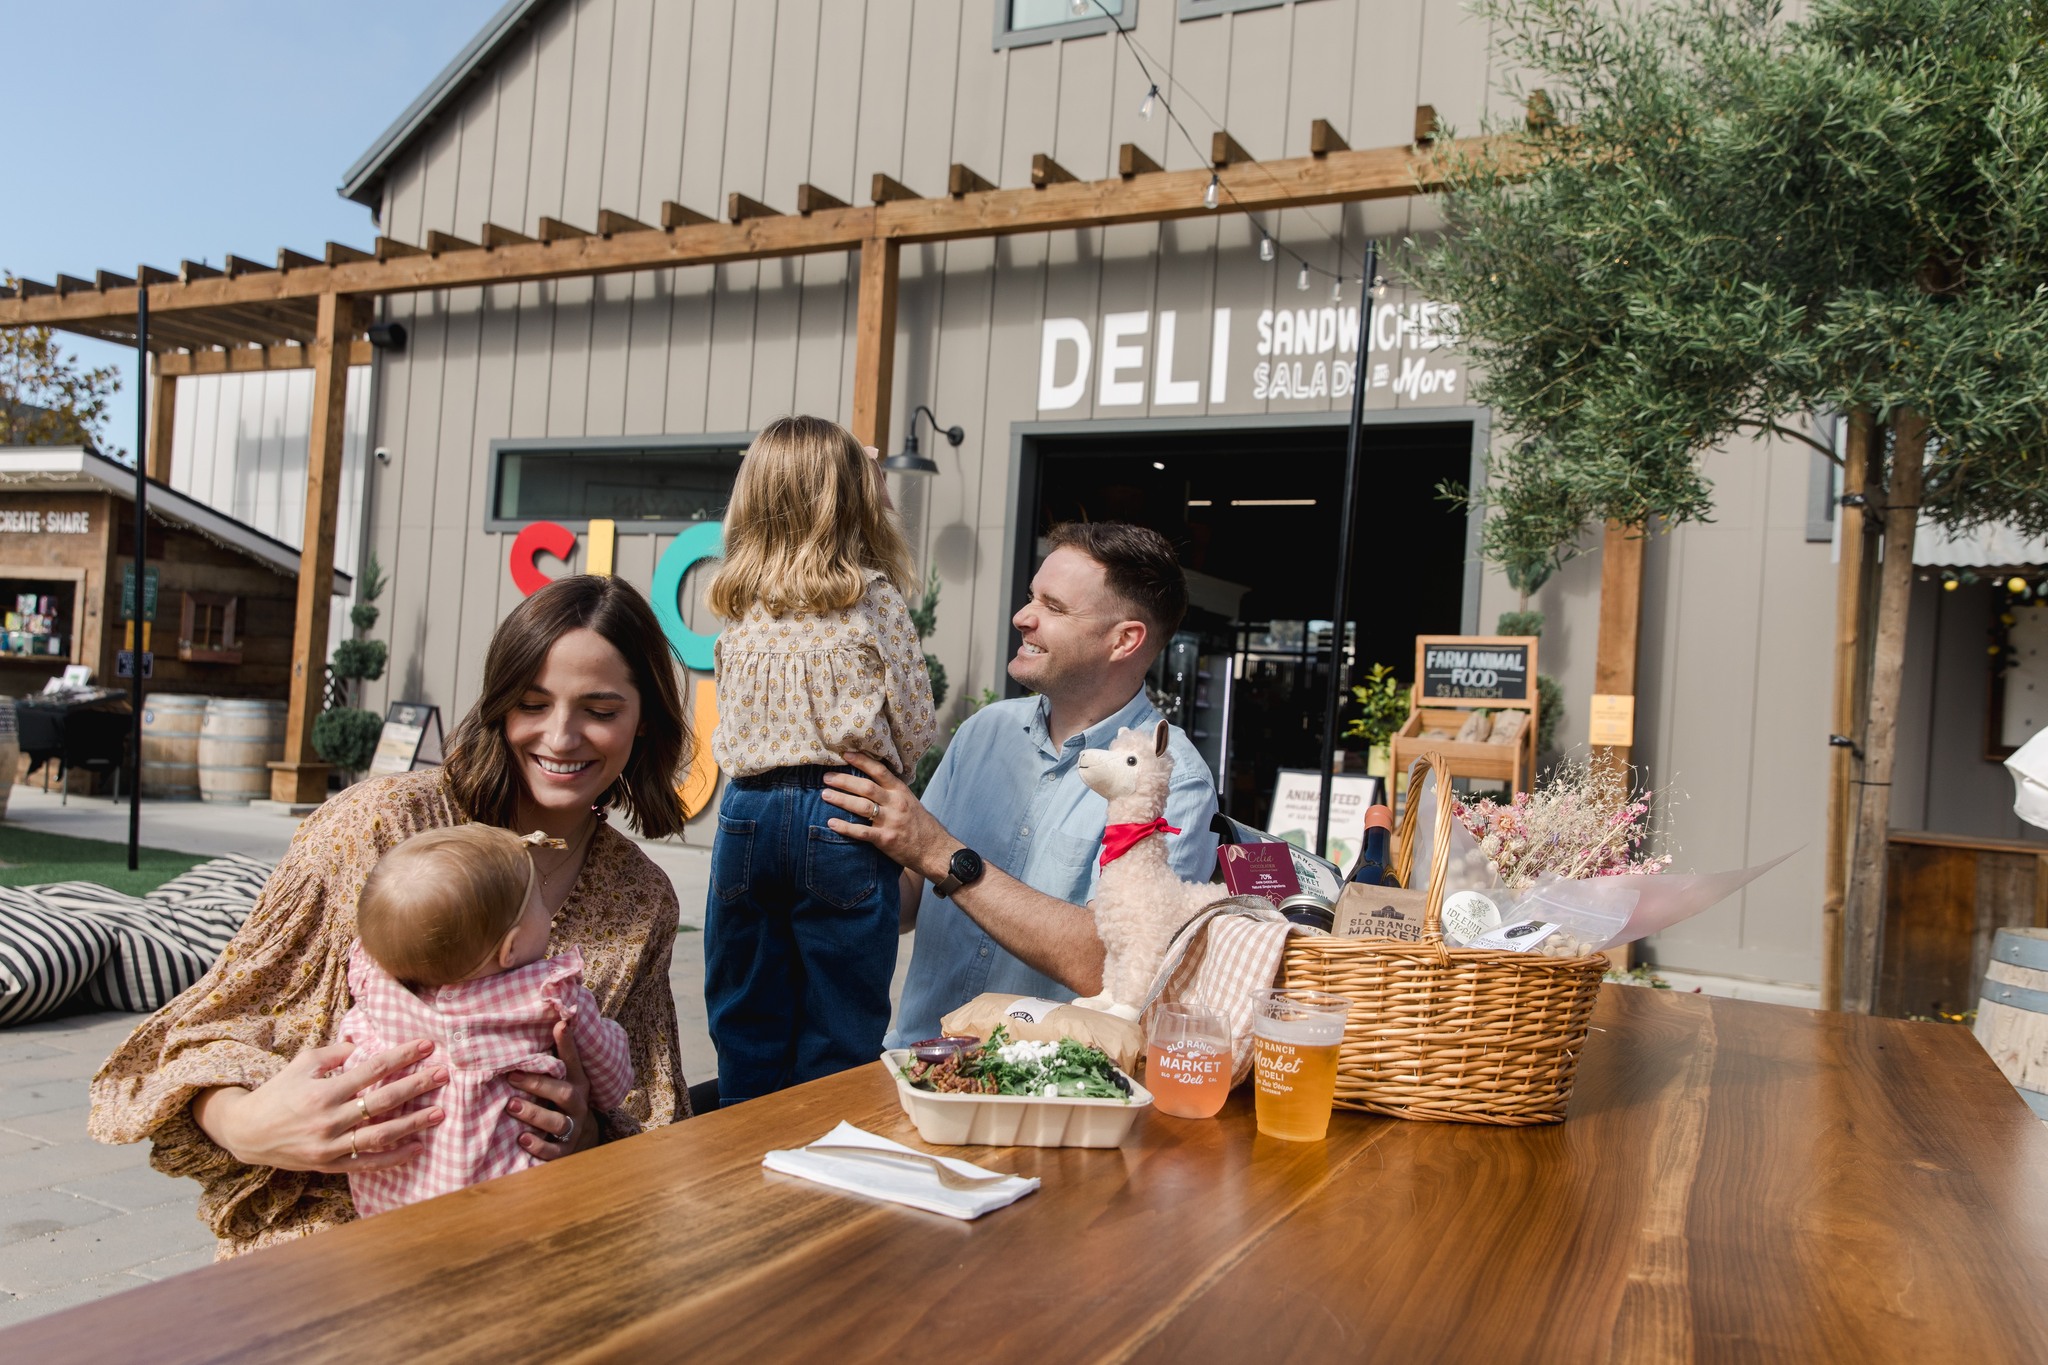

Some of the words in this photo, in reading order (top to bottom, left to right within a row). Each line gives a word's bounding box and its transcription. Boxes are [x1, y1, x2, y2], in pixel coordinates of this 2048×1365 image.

[1037, 307, 1231, 411] DELI
[1393, 358, 1456, 400] More
[46, 511, 90, 534] SHARE
[1426, 650, 1469, 669] FARM
[1469, 651, 1525, 672] ANIMAL
[1451, 668, 1498, 688] FOOD
[1451, 685, 1461, 697] A
[1348, 926, 1421, 943] MARKET
[1350, 918, 1373, 927] SLO
[1377, 919, 1421, 935] RANCH
[1166, 1040, 1184, 1054] SLO
[1186, 1039, 1218, 1059] RANCH
[1264, 1041, 1296, 1055] RANCH
[1159, 1055, 1222, 1073] MARKET
[1254, 1047, 1304, 1074] Market
[1178, 1072, 1204, 1085] Deli
[1264, 1069, 1284, 1081] DELI
